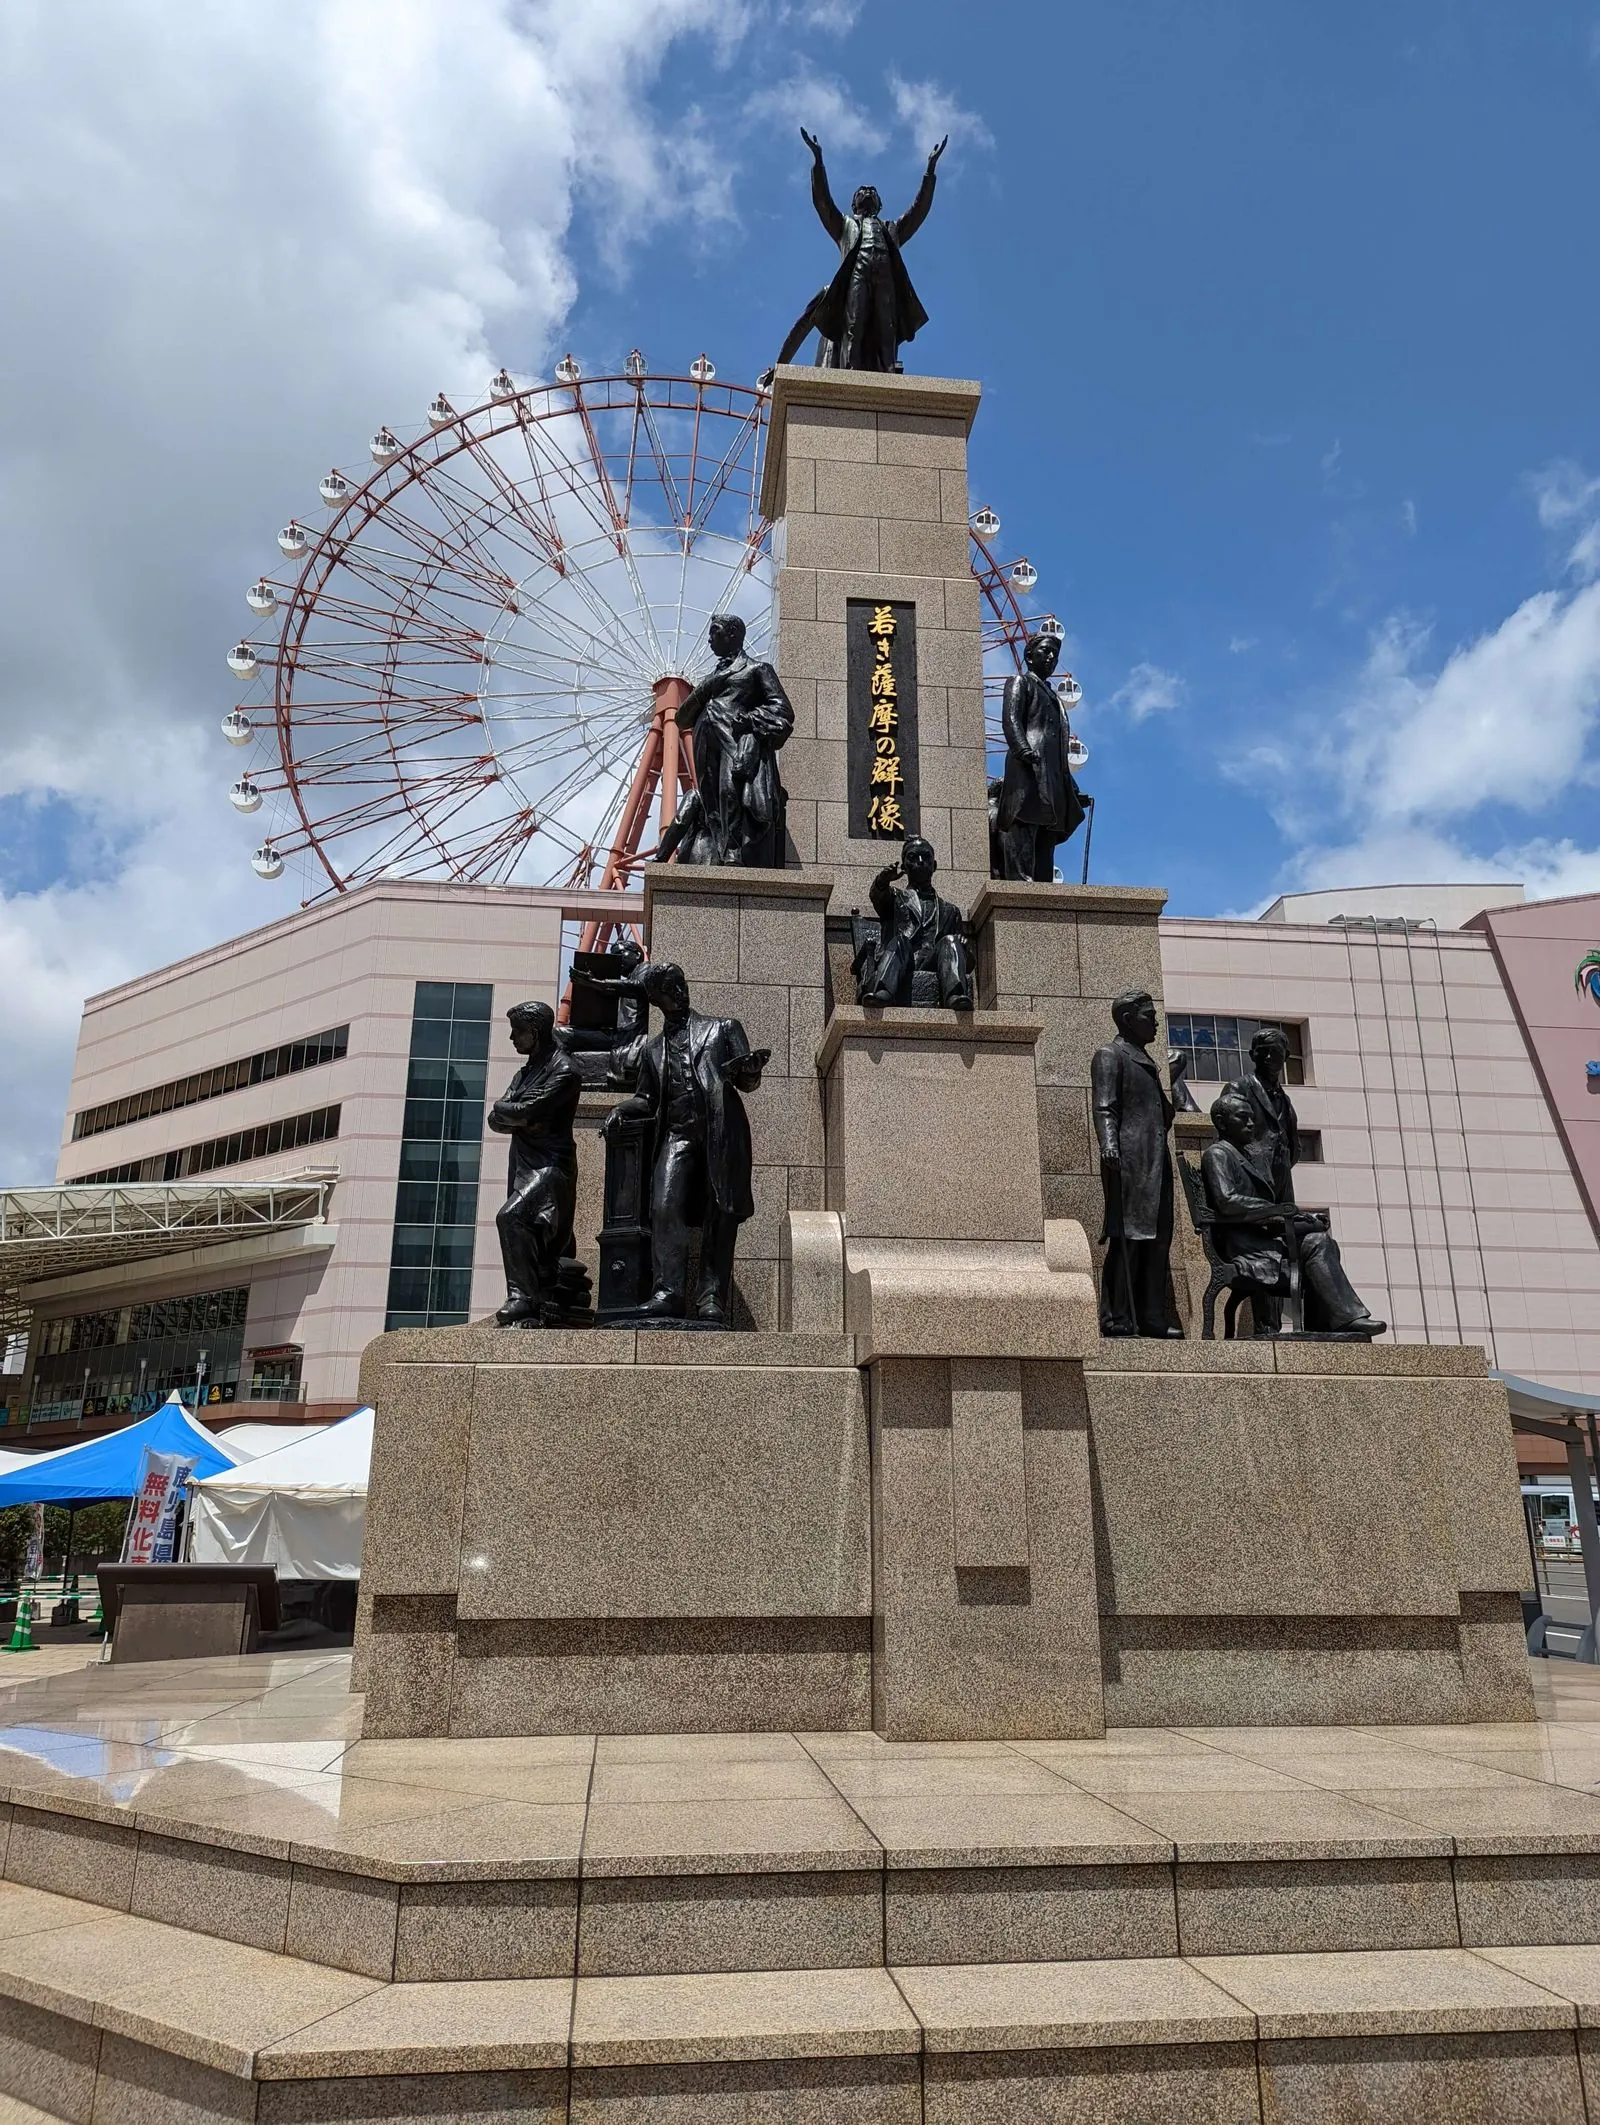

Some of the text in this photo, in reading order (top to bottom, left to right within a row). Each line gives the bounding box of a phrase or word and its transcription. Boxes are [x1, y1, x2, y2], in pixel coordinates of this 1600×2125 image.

[868, 605, 904, 830] 若き薩摩の群像
